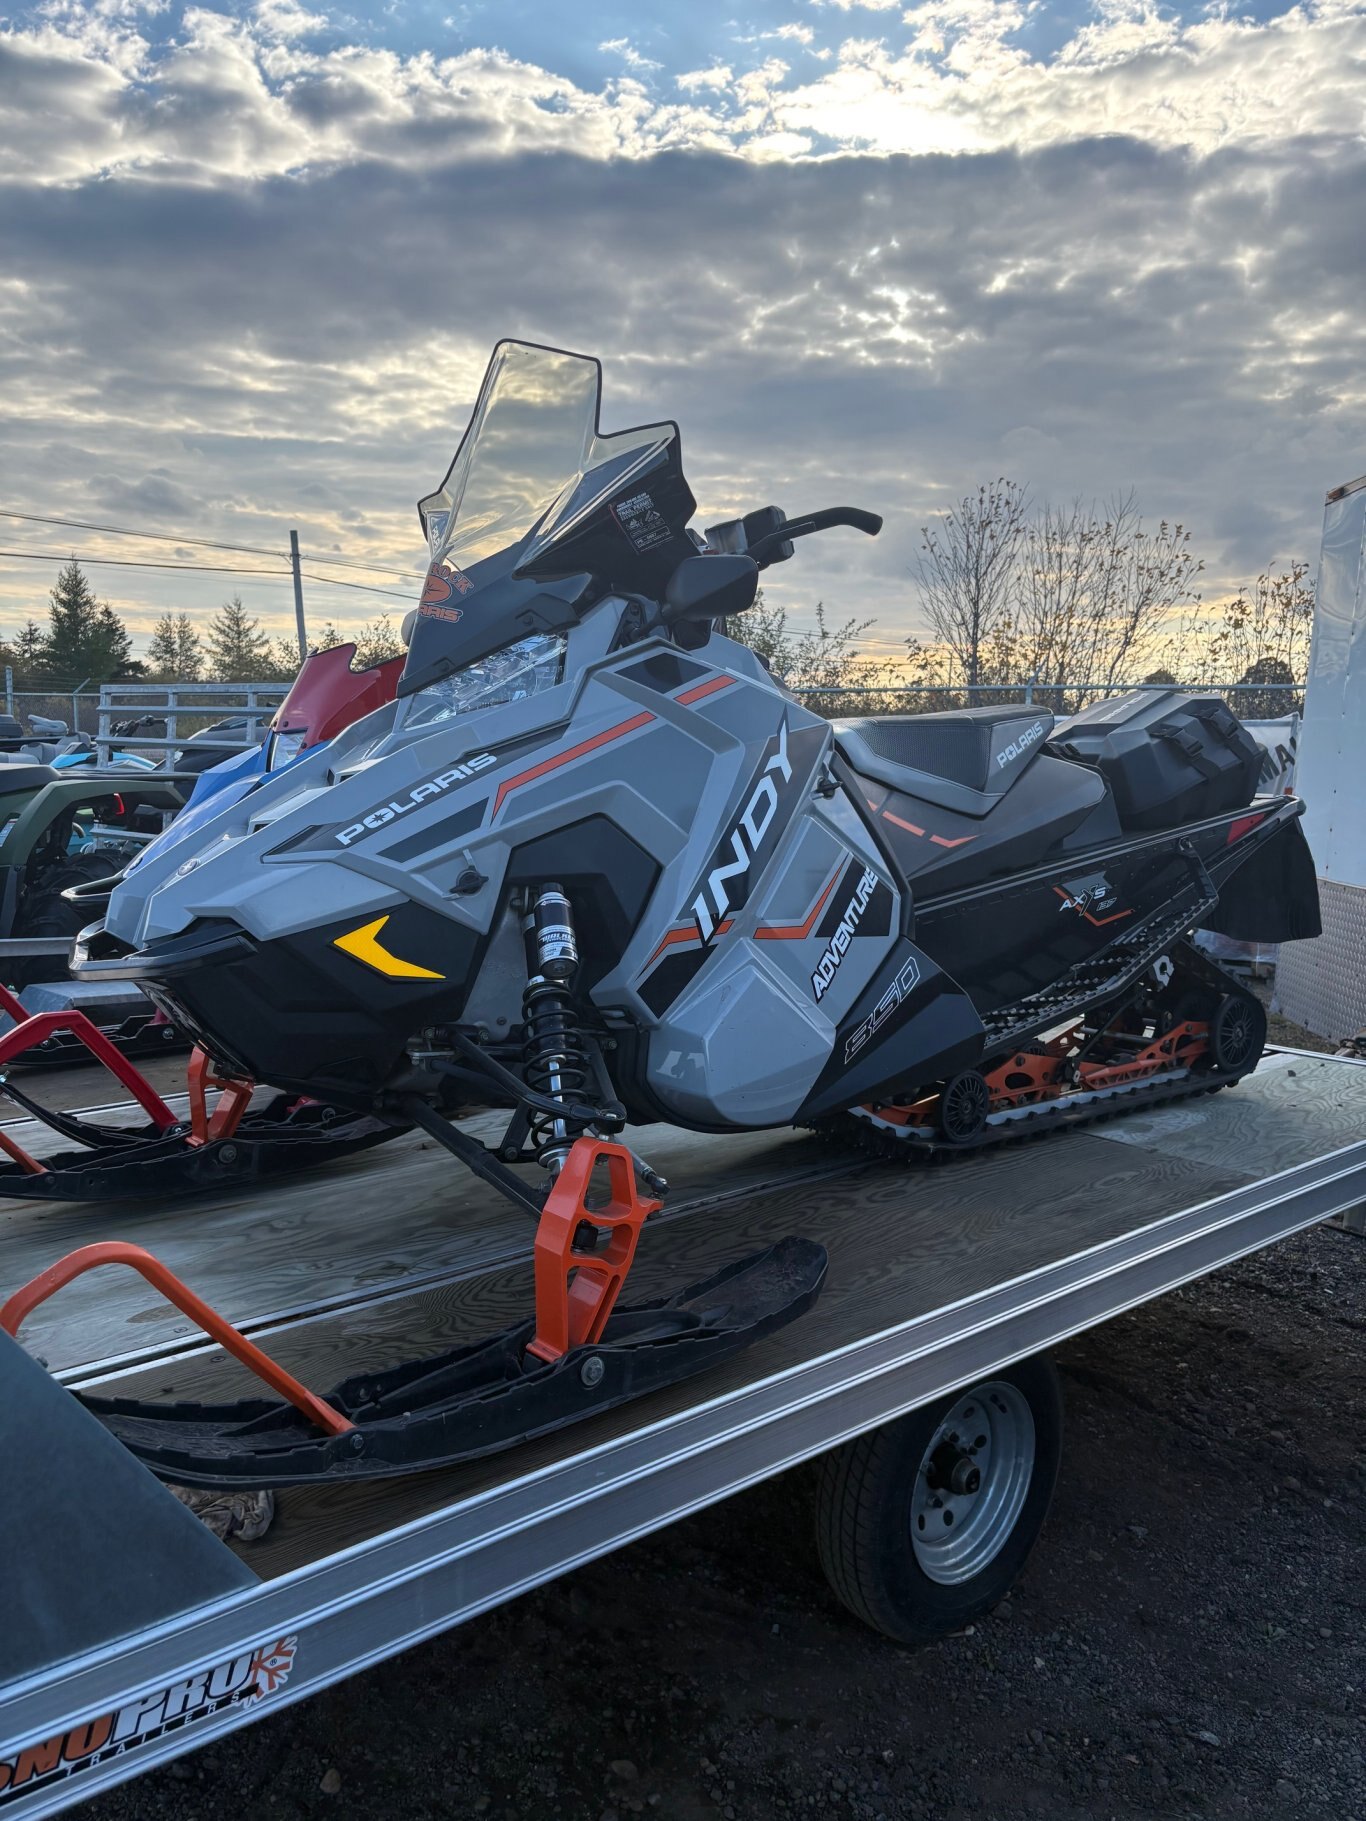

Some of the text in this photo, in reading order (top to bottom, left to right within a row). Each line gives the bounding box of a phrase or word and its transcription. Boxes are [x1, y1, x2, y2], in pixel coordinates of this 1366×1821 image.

[996, 720, 1043, 769] POLARIS
[334, 752, 498, 846] POLARIS
[690, 717, 793, 943] INDY
[812, 865, 877, 1001] ADVENTURE
[1058, 884, 1107, 917] AXYS
[843, 956, 922, 1065] 850
[65, 1691, 241, 1777] TRAILERS
